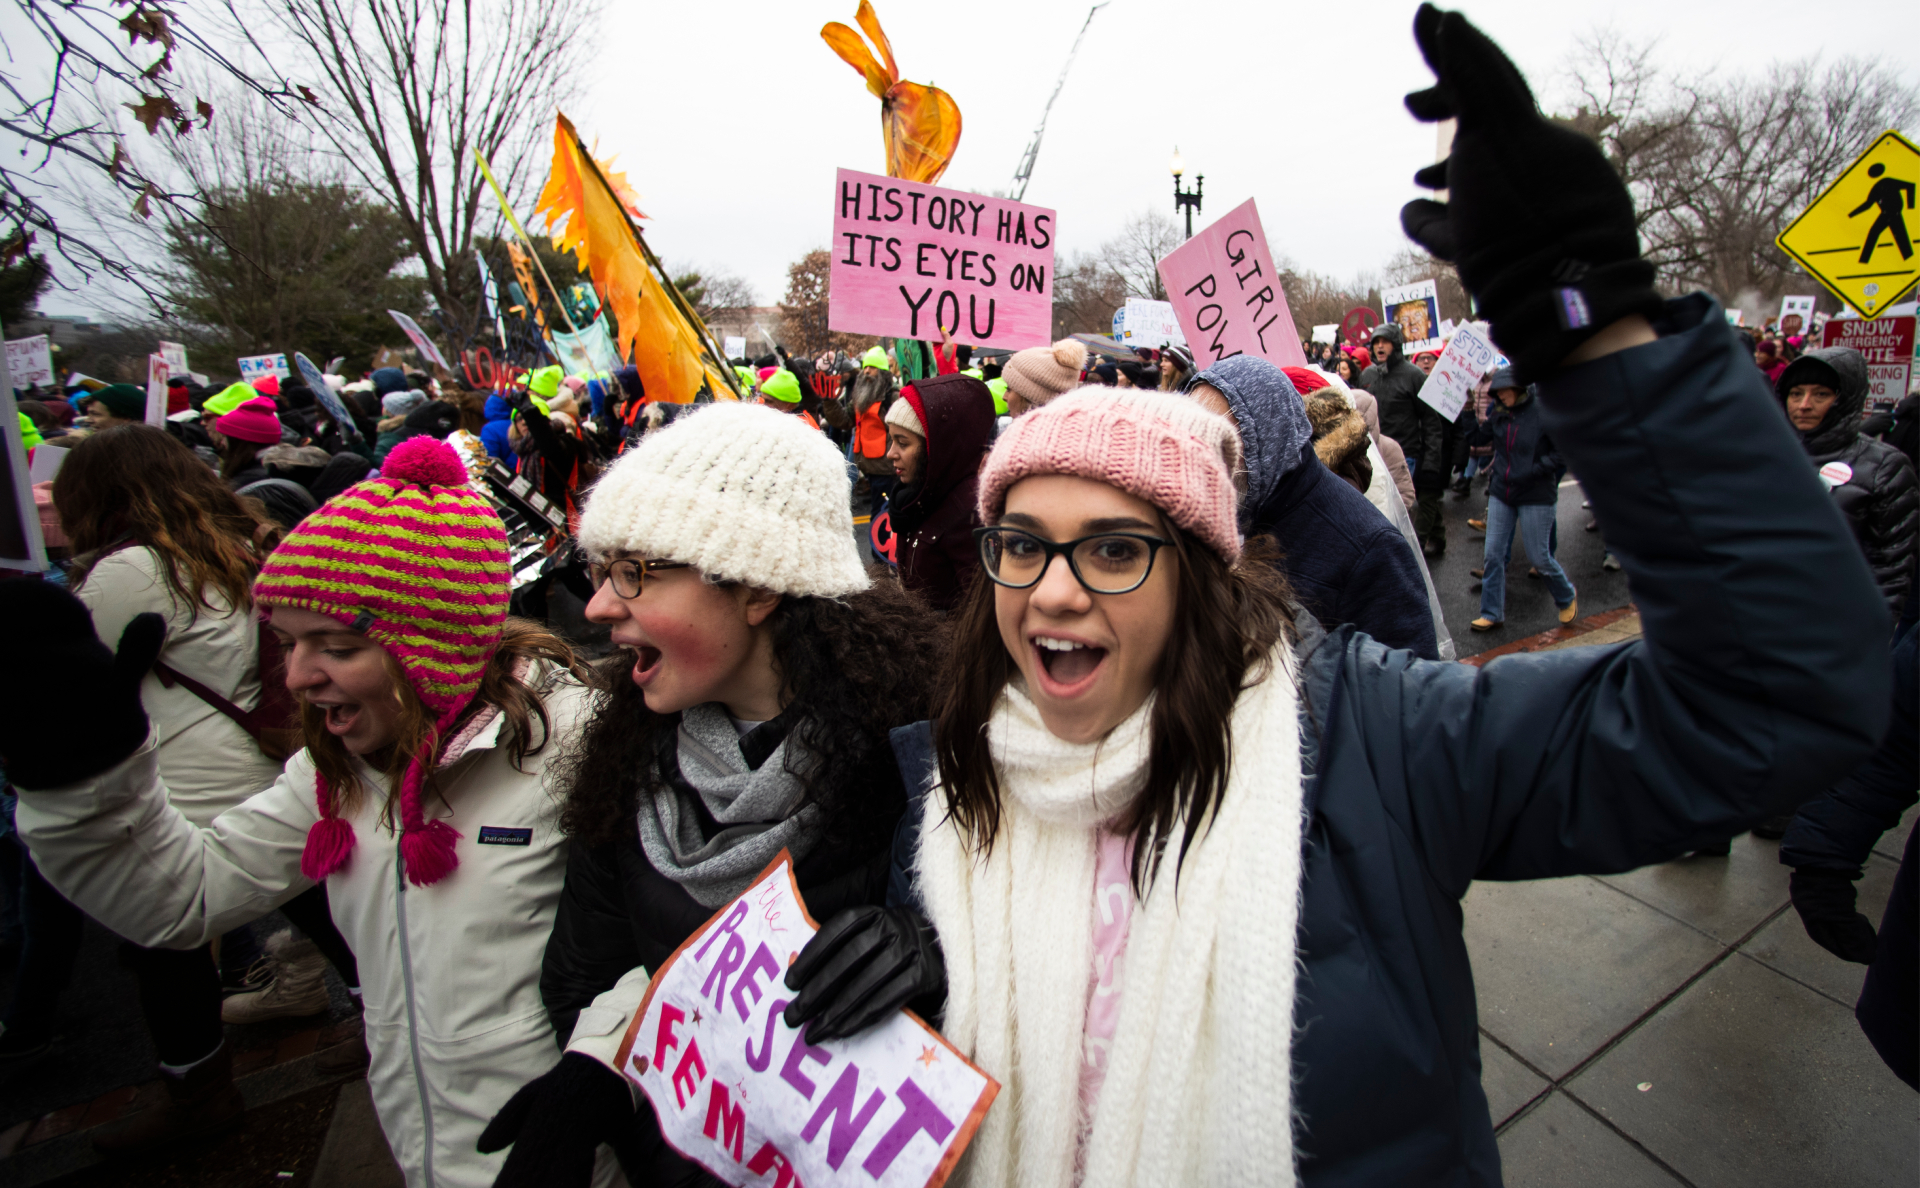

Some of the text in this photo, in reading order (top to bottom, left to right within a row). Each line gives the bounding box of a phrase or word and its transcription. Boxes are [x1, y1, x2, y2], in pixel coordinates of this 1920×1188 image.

[841, 180, 1050, 249] HISTORY HAS
[841, 232, 1044, 294] ITS EYES ON
[1225, 229, 1278, 354] GIRL
[1385, 285, 1433, 305] CAGE
[899, 285, 995, 339] YOU
[1128, 302, 1148, 318] HERE
[1184, 273, 1243, 361] POW
[1832, 335, 1904, 348] EMERGENCY
[1841, 319, 1896, 337] SNOW
[5, 338, 48, 357] RUMP
[1453, 329, 1493, 366] STD
[1861, 347, 1895, 363] UTE
[10, 359, 21, 371] S
[13, 369, 49, 386] AITOR
[460, 346, 531, 398] LOVE
[809, 370, 843, 399] VOTE
[484, 836, 524, 844] patagonia
[756, 881, 787, 931] the
[694, 899, 955, 1180] PRESENT
[653, 1001, 806, 1188] FEMA
[735, 1076, 751, 1104] is
